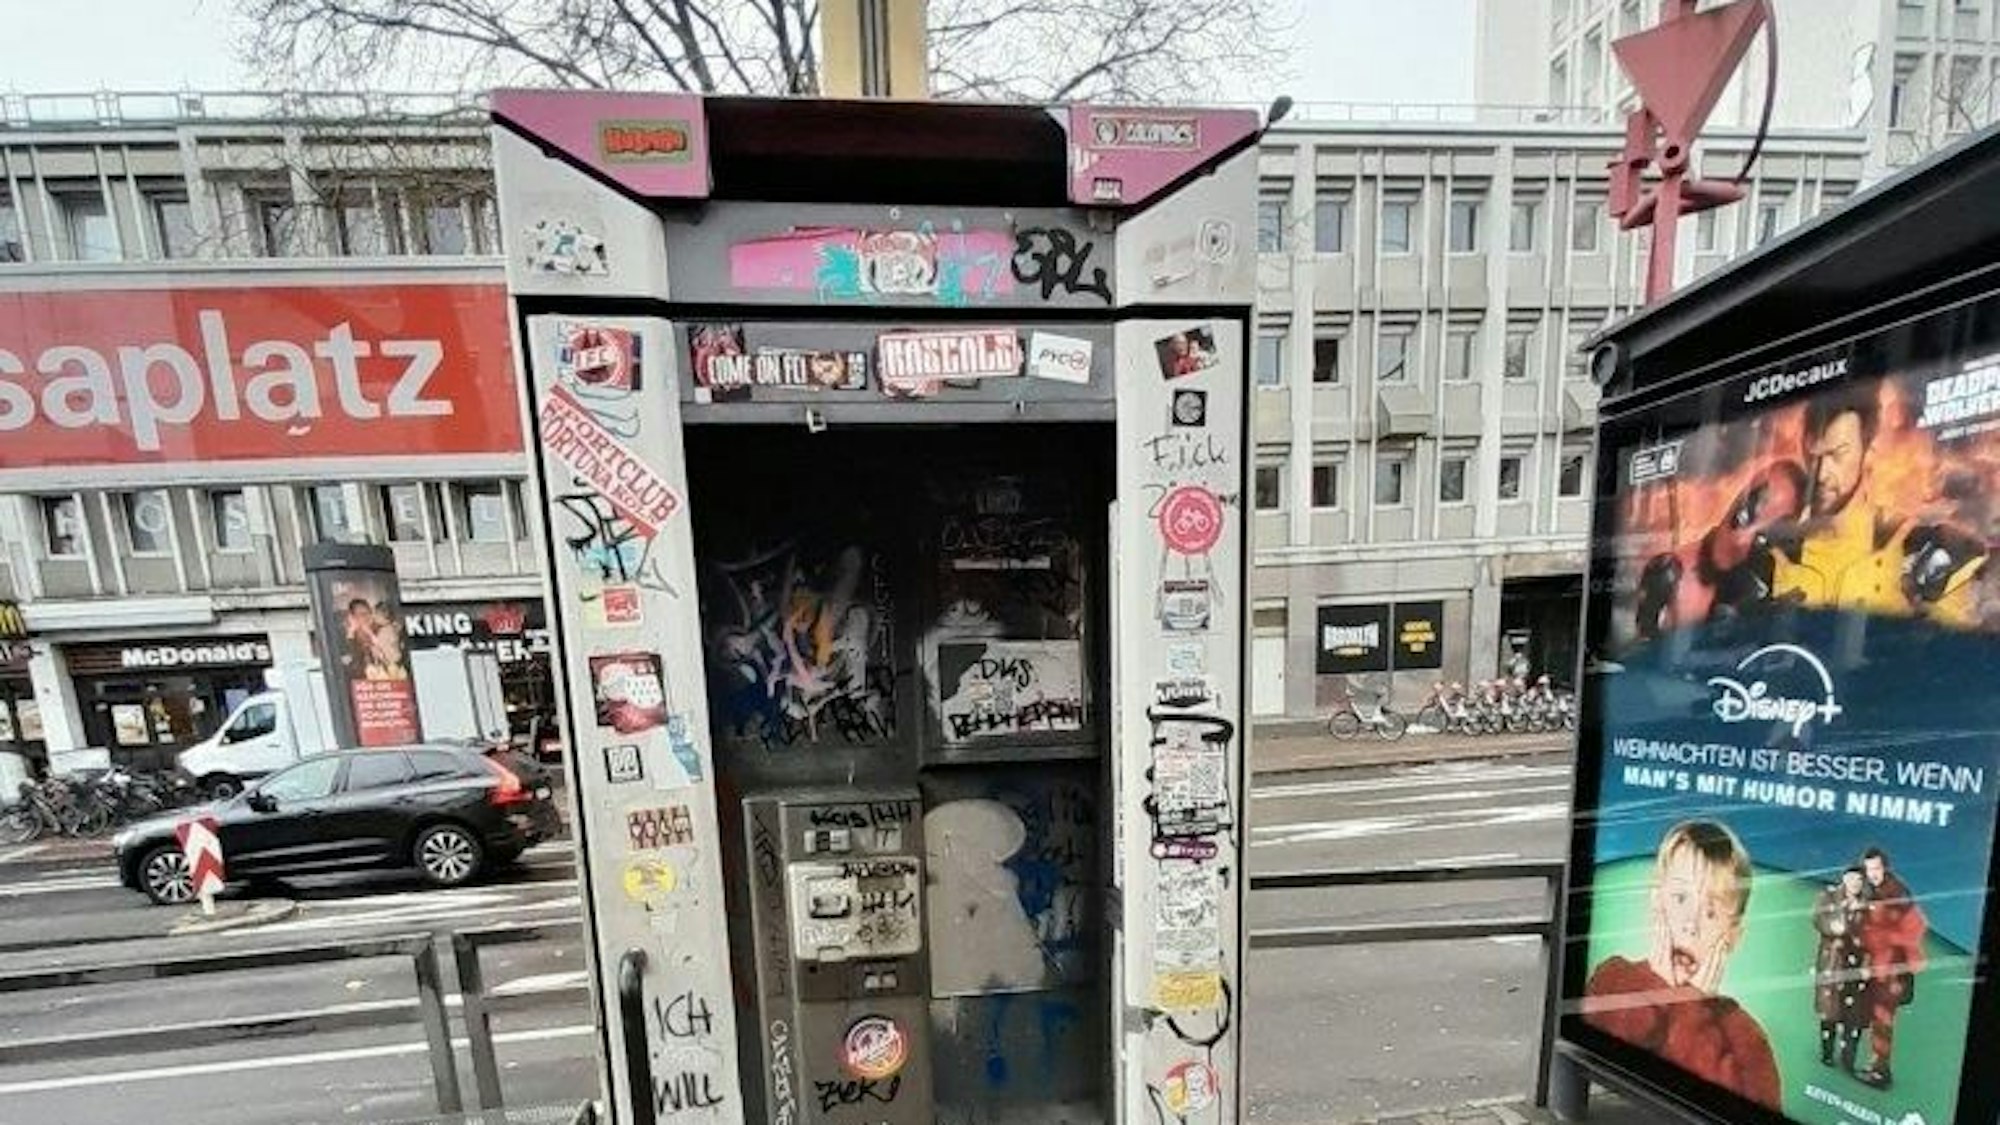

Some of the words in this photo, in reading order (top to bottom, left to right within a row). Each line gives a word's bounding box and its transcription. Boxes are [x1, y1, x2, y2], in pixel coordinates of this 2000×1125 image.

[0, 310, 454, 452] saplatz
[707, 355, 751, 386] COME
[757, 355, 780, 385] ON
[1743, 357, 1849, 403] JCDecaux
[1925, 366, 2000, 406] DEADP
[551, 397, 678, 521] SPORTCLUB
[405, 612, 473, 637] KING
[121, 642, 271, 668] McDonald's
[1613, 738, 1746, 769] WEIHNACHTEN
[1750, 747, 1780, 773] IST
[1896, 761, 1984, 794] WENN
[1623, 767, 1689, 792] MAN'S
[1697, 774, 1737, 796] MIT
[1742, 780, 1836, 813] HUMOR
[1845, 793, 1955, 828] NIMMT
[653, 991, 713, 1042] ICH
[653, 1069, 724, 1117] WILL
